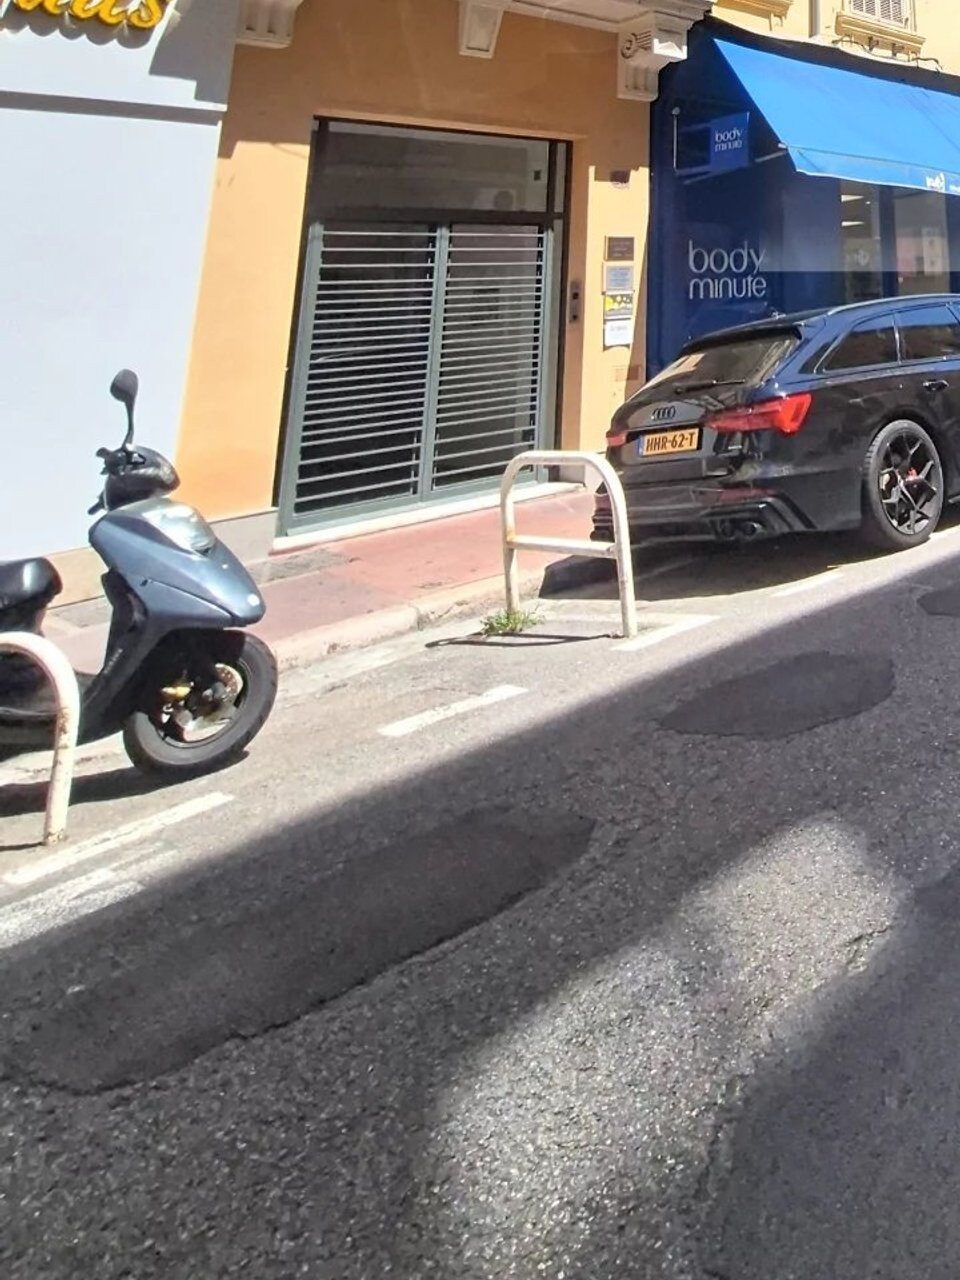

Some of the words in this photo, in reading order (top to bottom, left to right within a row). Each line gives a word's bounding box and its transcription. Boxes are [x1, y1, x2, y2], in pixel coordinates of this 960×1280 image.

[714, 127, 744, 144] body
[688, 239, 767, 274] body
[688, 275, 767, 300] minute
[645, 431, 697, 453] HHR-62-T
